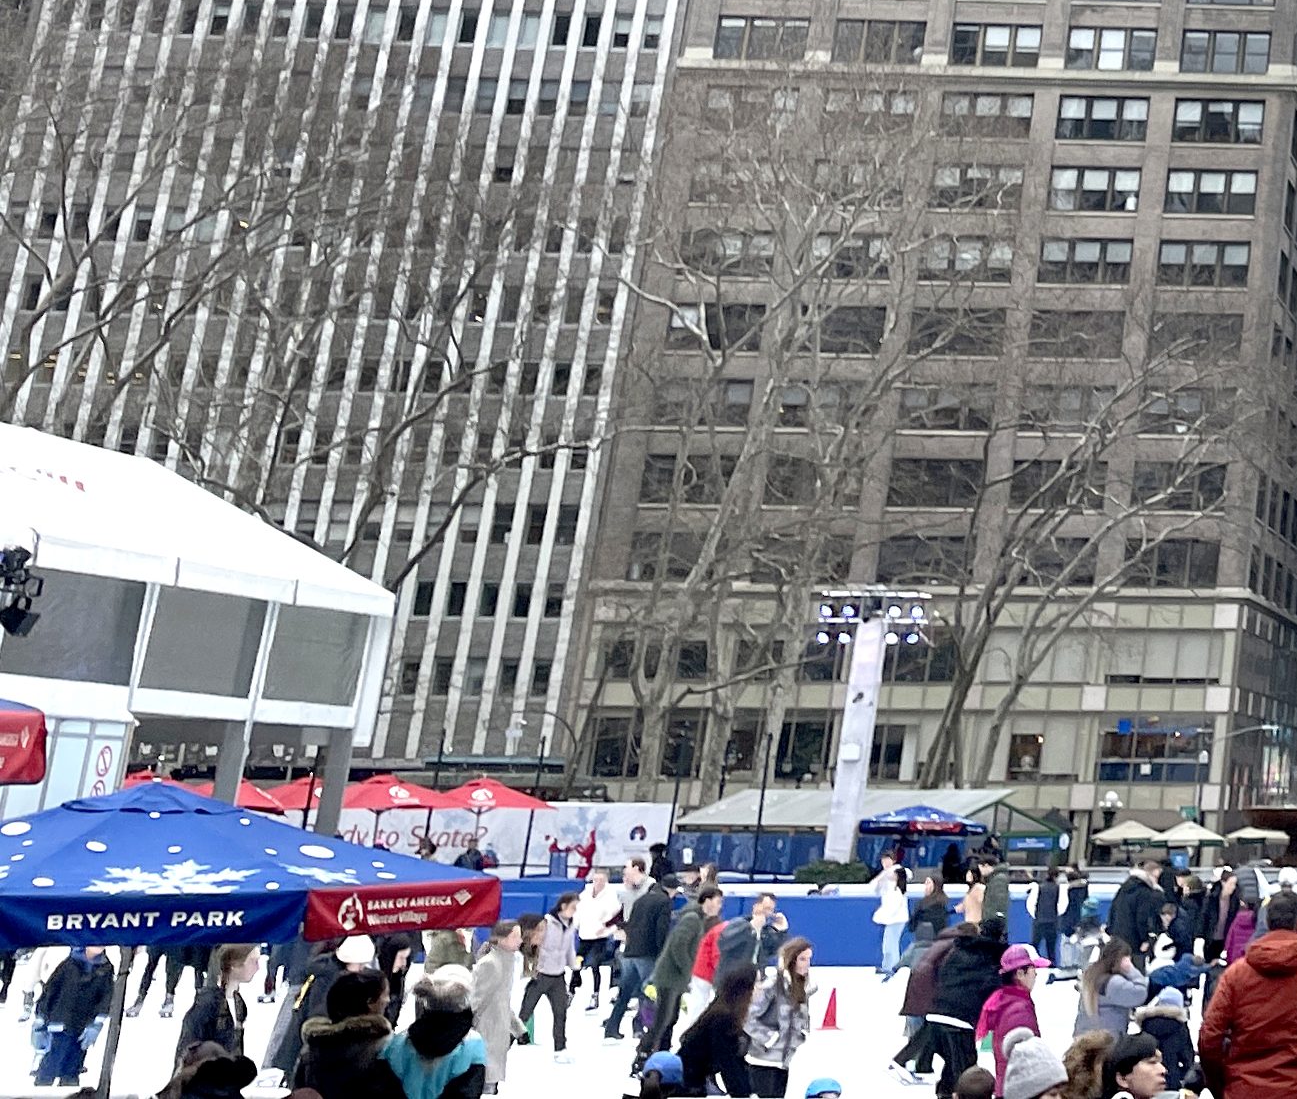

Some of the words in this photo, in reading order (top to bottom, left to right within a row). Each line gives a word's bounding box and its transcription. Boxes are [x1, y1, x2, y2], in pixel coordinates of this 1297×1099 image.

[408, 824, 488, 848] Sate?
[367, 899, 395, 911] BANK
[396, 897, 409, 909] OF
[409, 895, 452, 908] AMERICA
[47, 912, 160, 931] BRYANT
[170, 910, 245, 928] PARK
